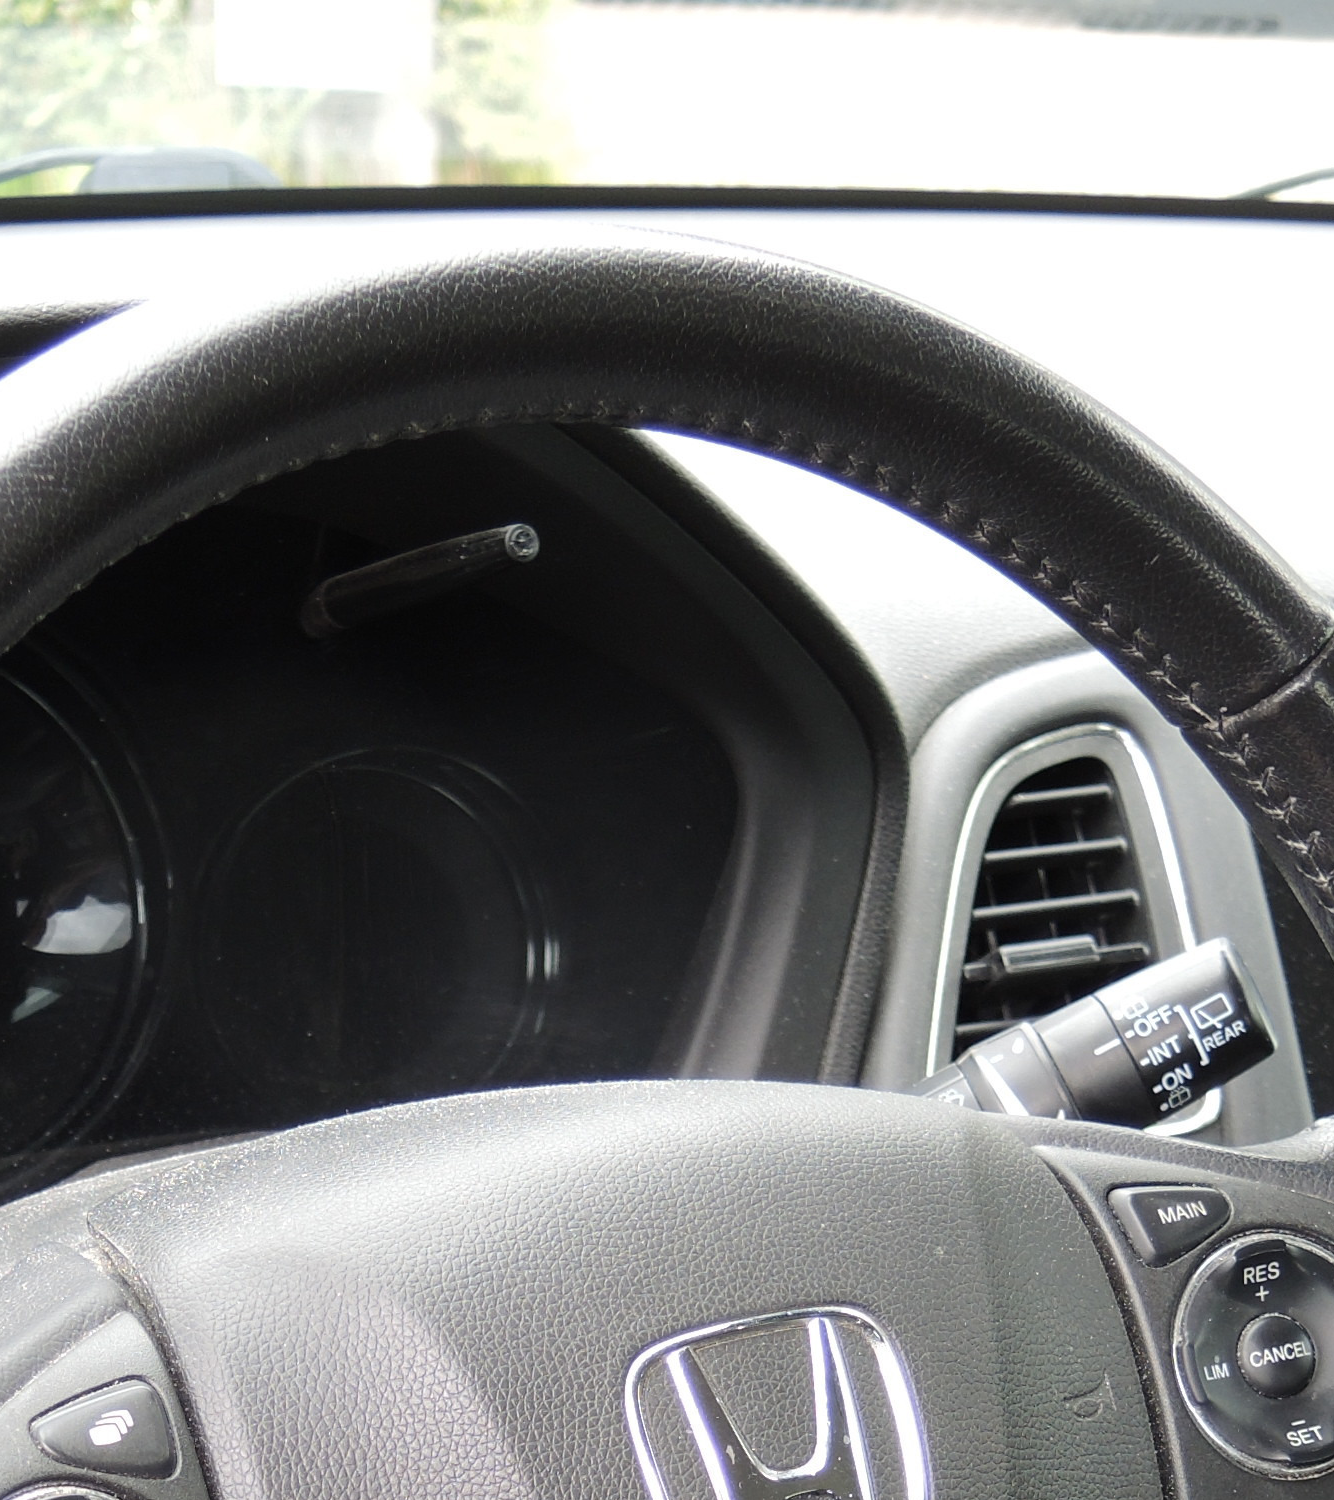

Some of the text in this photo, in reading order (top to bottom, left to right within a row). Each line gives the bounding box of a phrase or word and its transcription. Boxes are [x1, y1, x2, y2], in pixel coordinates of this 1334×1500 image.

[1133, 1005, 1172, 1038] OFF
[1203, 1020, 1247, 1052] REAR
[1146, 1036, 1181, 1067] INT
[1160, 1064, 1194, 1091] ON
[1157, 1201, 1207, 1225] MAIN
[1243, 1262, 1280, 1284] RES
[1249, 1342, 1311, 1368] CANCEL
[1204, 1362, 1230, 1381] LIM
[1286, 1425, 1323, 1447] SET
